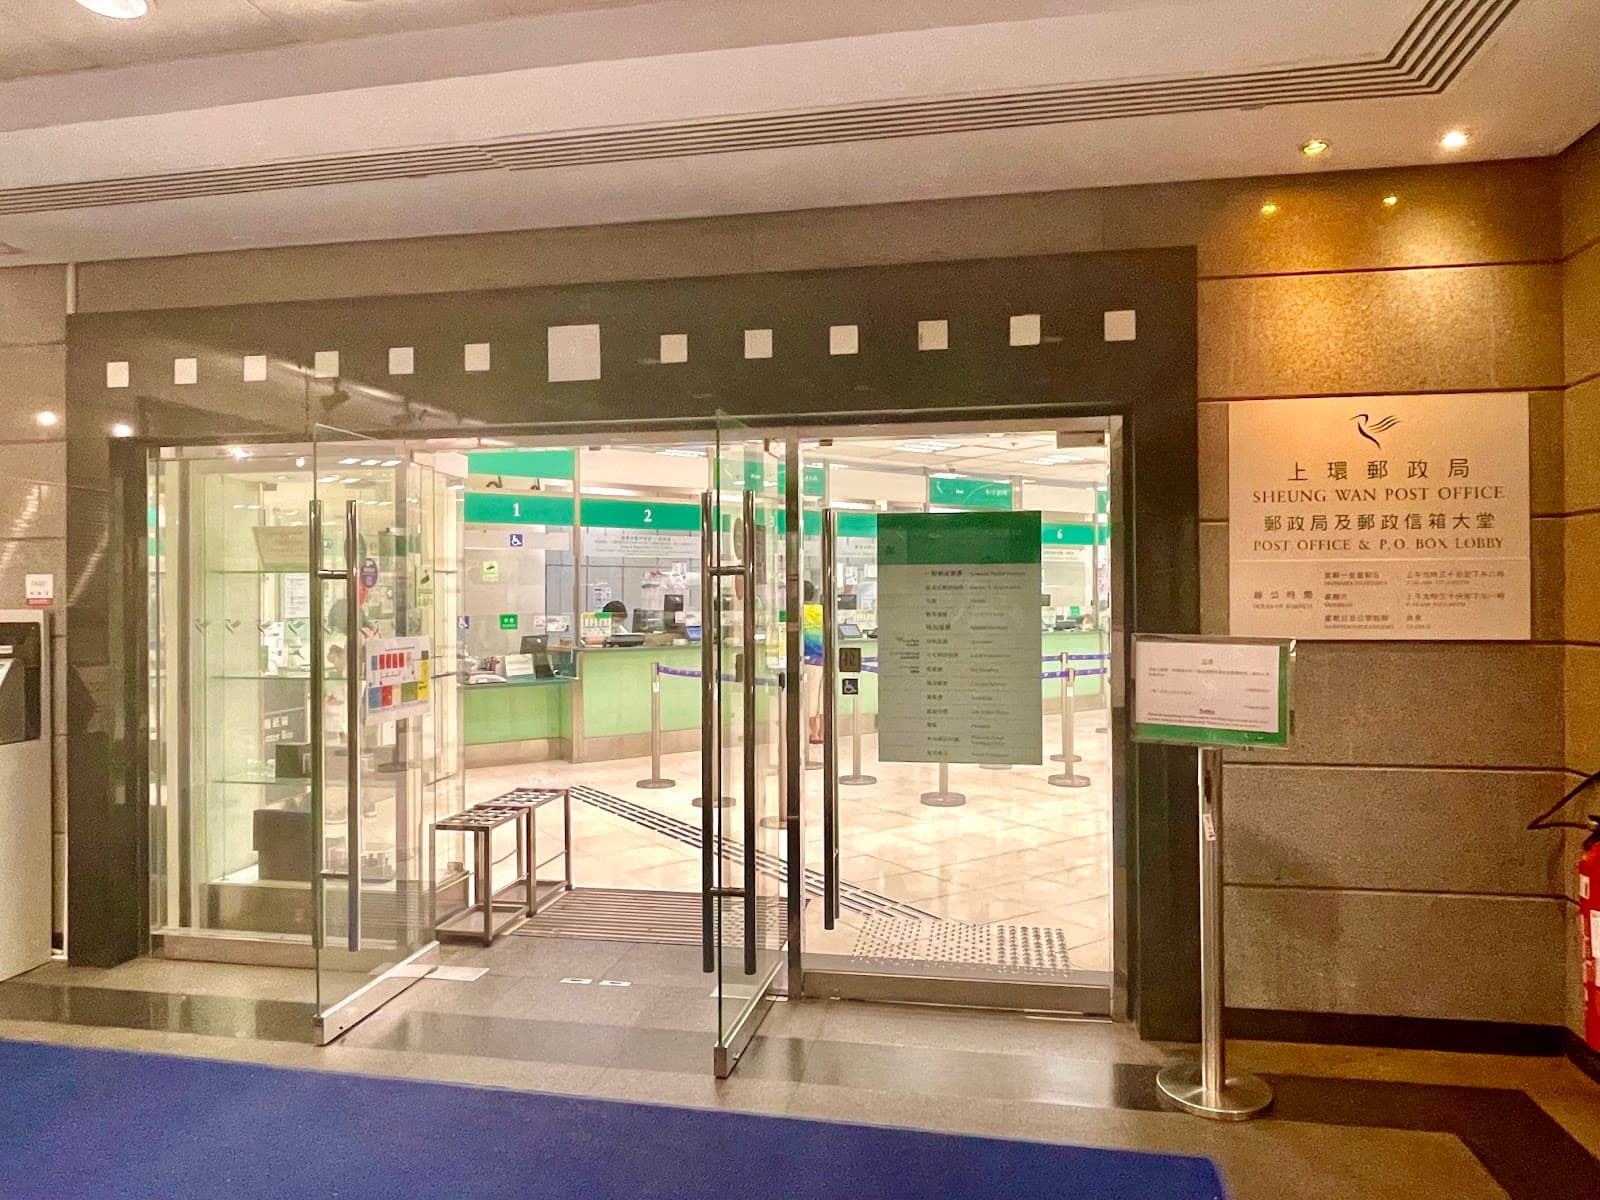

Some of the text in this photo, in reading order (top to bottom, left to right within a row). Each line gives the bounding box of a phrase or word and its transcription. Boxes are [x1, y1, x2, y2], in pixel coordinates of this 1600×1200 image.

[1287, 458, 1470, 481] 上環郵政局
[1252, 485, 1505, 503] SHEUNG WAN POST OFFICE
[512, 502, 521, 517] 1
[643, 509, 653, 522] 2
[1264, 512, 1495, 532] 郵政局及郵政信箱大堂
[1056, 529, 1064, 540] 6
[1253, 537, 1503, 551] POST OFFICE & P.O. BOX LOBBY
